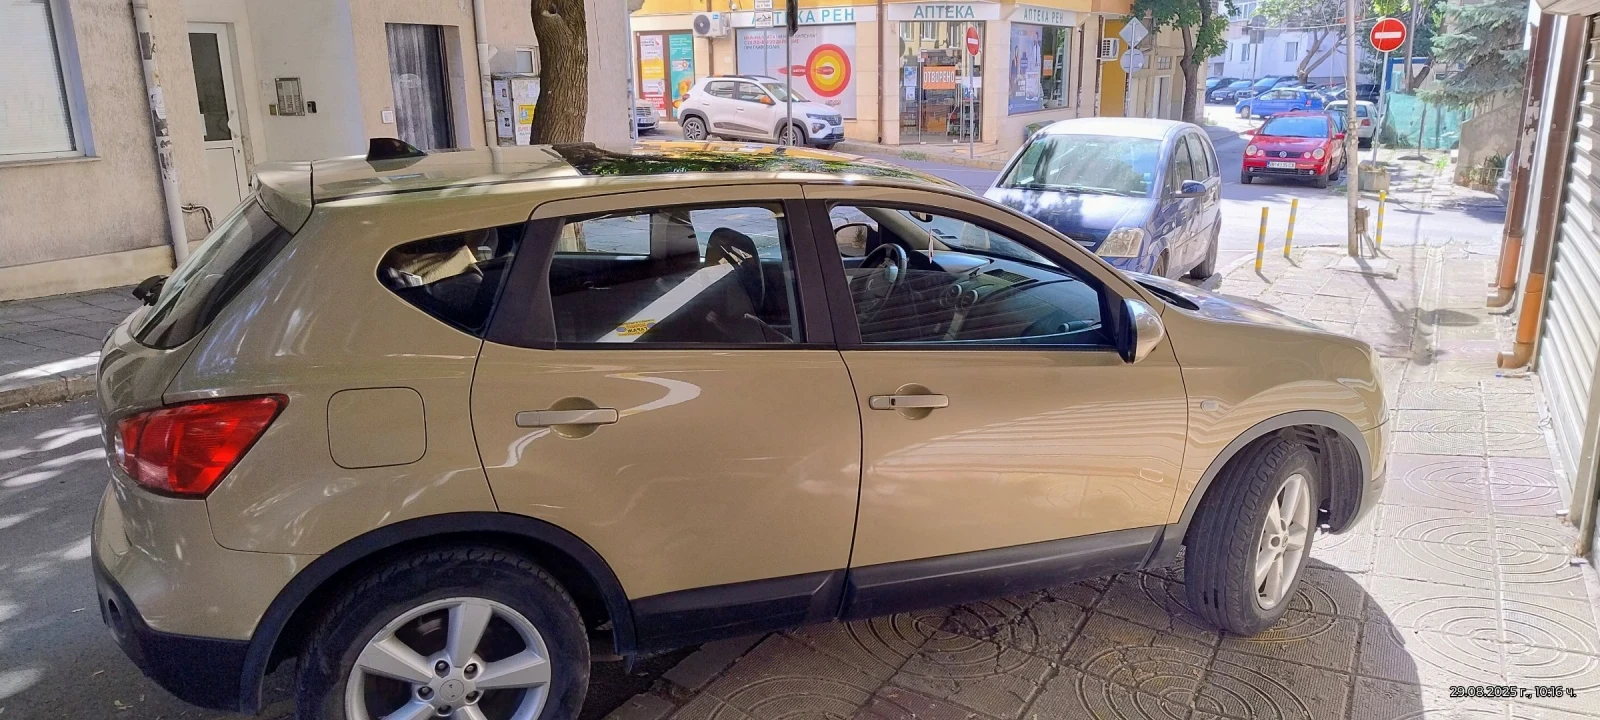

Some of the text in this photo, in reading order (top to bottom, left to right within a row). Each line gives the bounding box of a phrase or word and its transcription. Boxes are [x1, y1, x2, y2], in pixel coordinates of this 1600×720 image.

[751, 8, 854, 25] ТКА РЕН
[913, 5, 975, 19] АПТЕКА
[1023, 8, 1064, 24] АПТЕКА РЕН
[923, 71, 955, 83] ОТВОРЕНО
